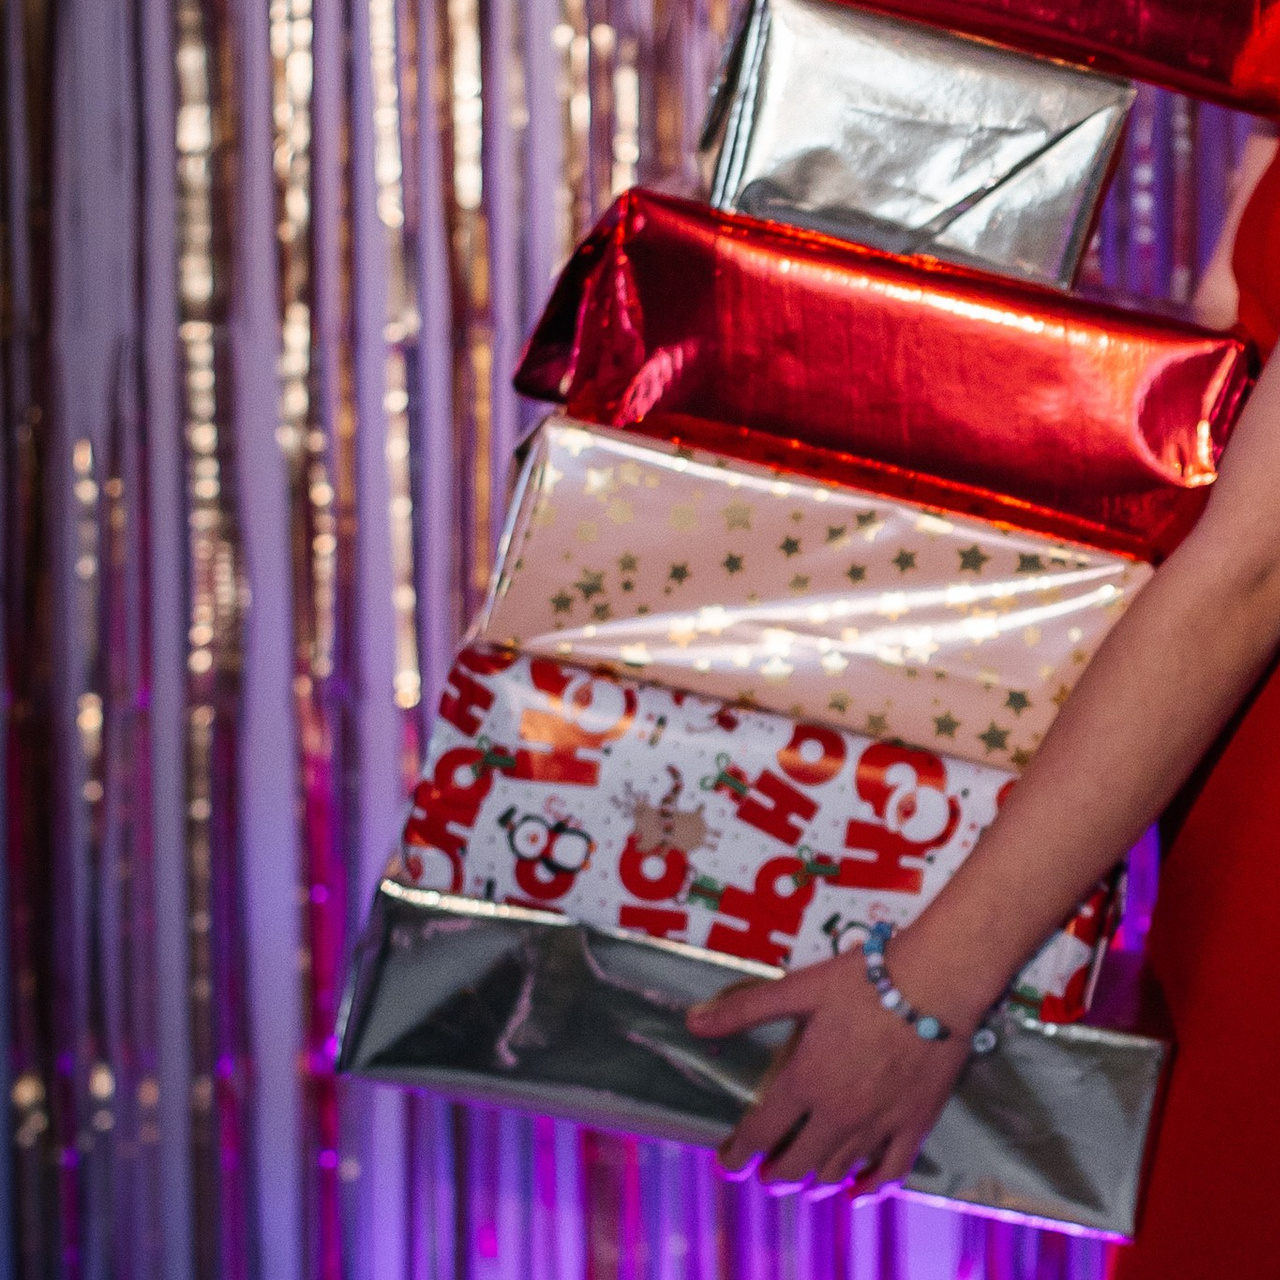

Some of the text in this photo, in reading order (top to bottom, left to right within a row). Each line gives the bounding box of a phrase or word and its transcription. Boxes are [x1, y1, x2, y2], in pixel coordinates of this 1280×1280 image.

[405, 747, 493, 850] HO
[736, 724, 847, 846] HO
[706, 856, 815, 967] HO
